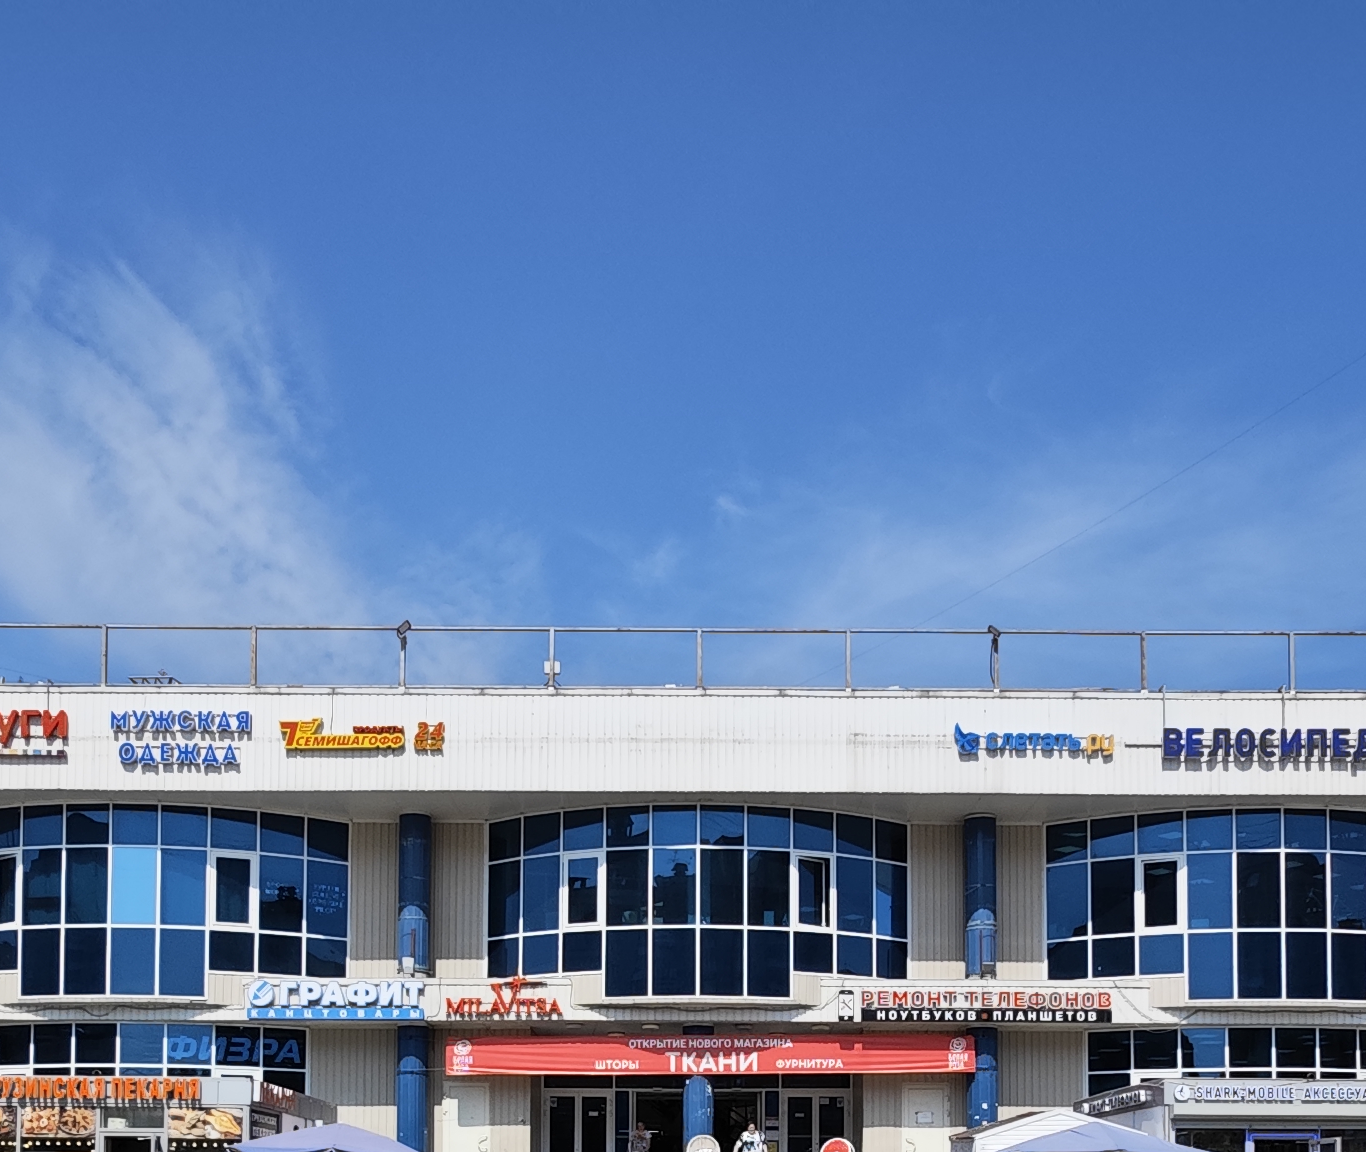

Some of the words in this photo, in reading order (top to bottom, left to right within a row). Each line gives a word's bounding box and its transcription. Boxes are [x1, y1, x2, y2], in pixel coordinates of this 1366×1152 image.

[110, 711, 252, 731] МУЖСКАЯ
[295, 734, 403, 747] СЕМИШАГОФФ
[413, 722, 445, 740] 24
[118, 743, 239, 765] ОДЕЖДА
[279, 981, 425, 1007] ГРАФИТ
[861, 990, 956, 1008] РЕМОНТ
[964, 991, 1112, 1009] ТЕЛЕФОНОВ
[250, 1008, 422, 1019] КАНЦТОВАРЫ
[876, 1010, 977, 1021] НОУТБУКОВ
[992, 1010, 1097, 1022] ПЛАНШЕТОВ
[168, 1035, 301, 1064] ФИЗРА
[629, 1038, 686, 1049] ОТКРЫТИЕ
[688, 1038, 732, 1048] НОВОГО
[734, 1037, 794, 1048] МАГАЗИНА
[595, 1059, 640, 1070] ШТОРЫ
[665, 1051, 759, 1073] ТКАНИ
[775, 1058, 844, 1069] ФУРНИТУРА
[111, 1077, 201, 1100] ПЕКАРНЯ
